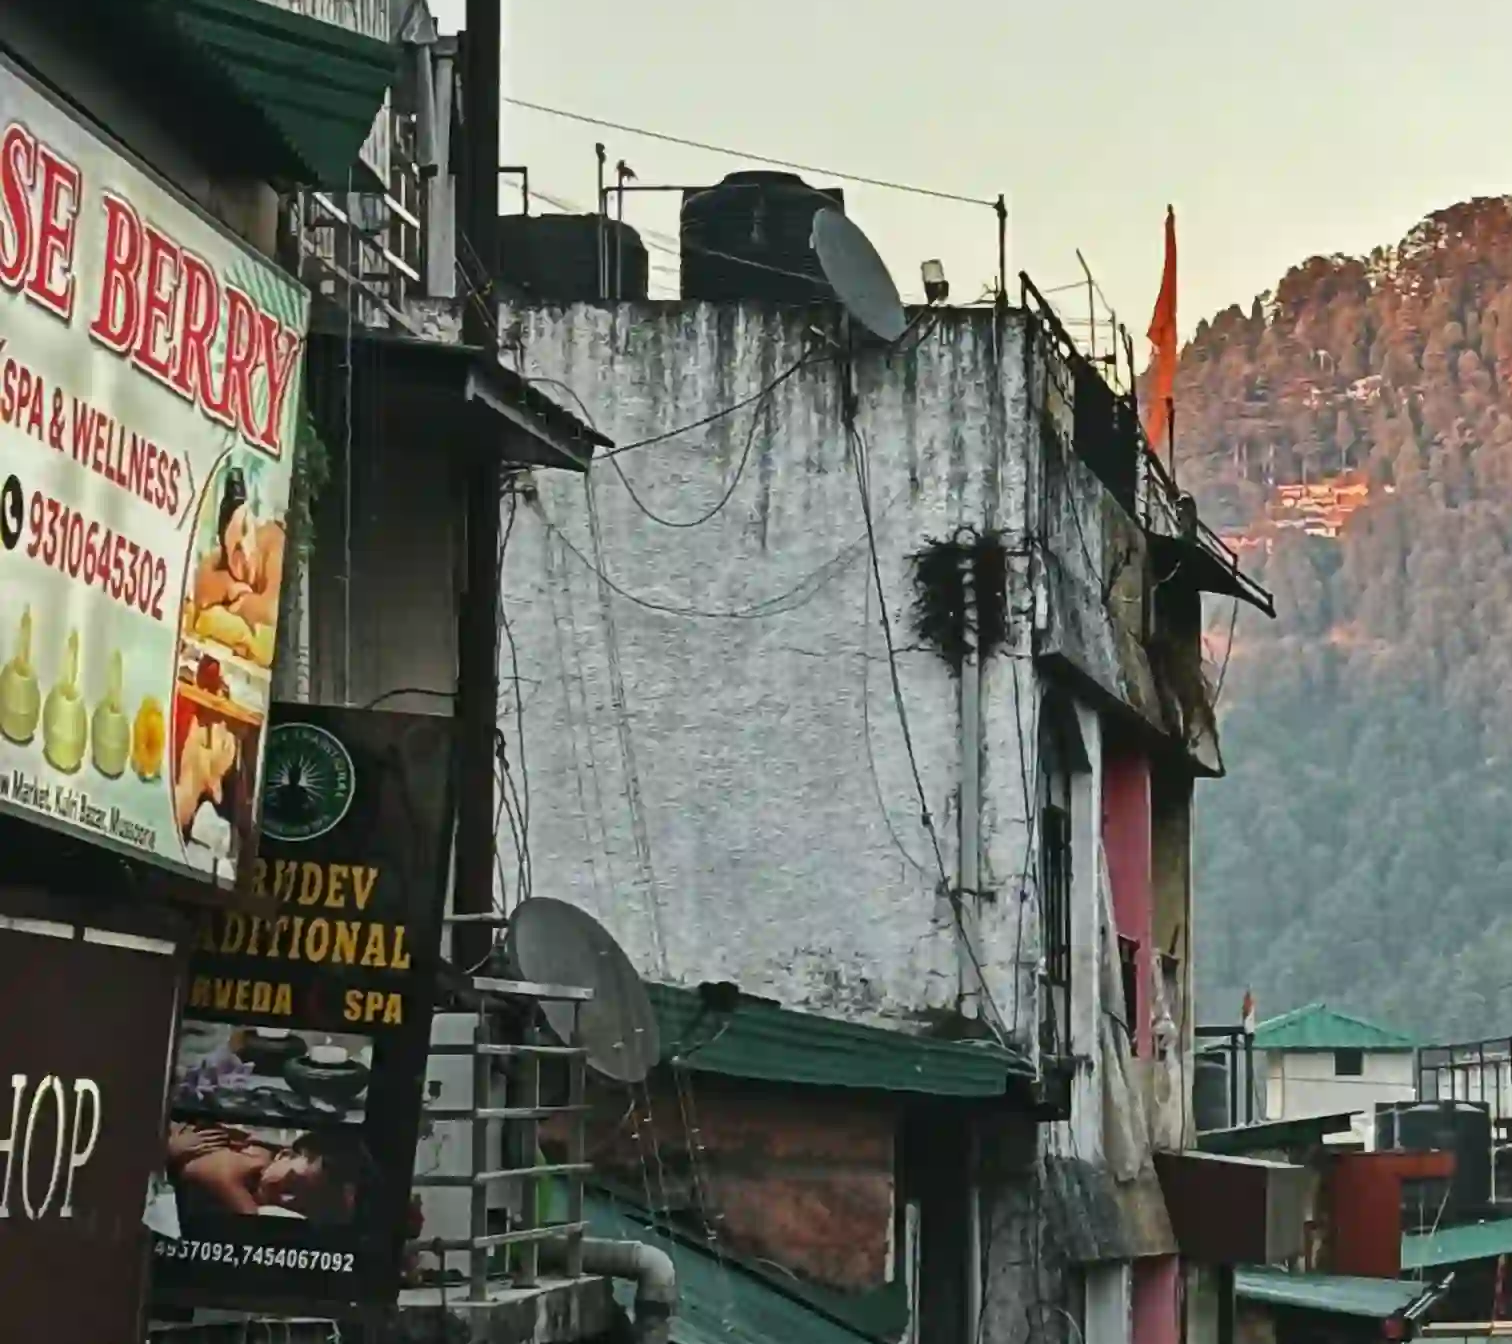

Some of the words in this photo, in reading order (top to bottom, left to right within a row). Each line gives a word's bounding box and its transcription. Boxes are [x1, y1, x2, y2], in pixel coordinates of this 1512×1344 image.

[0, 121, 82, 320] SE
[90, 193, 302, 459] BERRY
[1, 365, 46, 435] SPA
[49, 404, 66, 454] &
[70, 401, 182, 520] WELLNESS
[28, 498, 167, 622] 9310645302
[343, 988, 402, 1026] SPA
